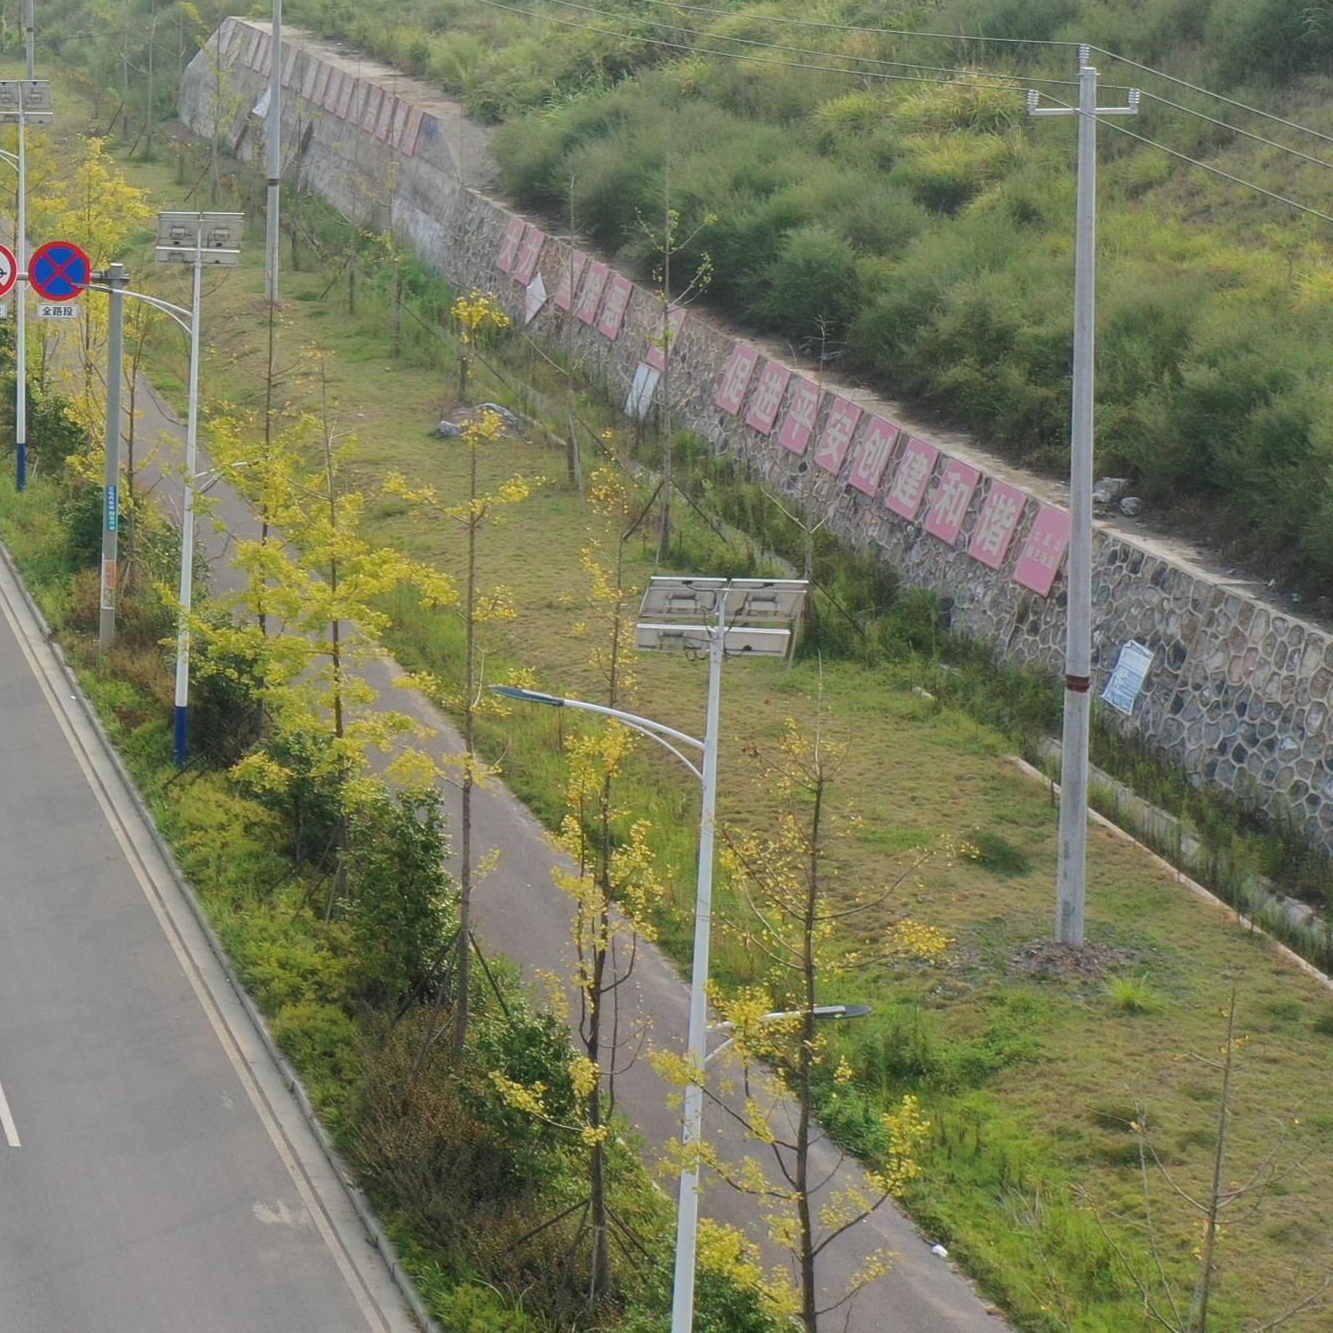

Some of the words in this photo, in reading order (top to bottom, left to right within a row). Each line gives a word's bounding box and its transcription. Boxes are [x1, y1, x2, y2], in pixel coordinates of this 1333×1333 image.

[42, 306, 73, 316] 全路段
[721, 354, 1017, 557] 促进平安创建和谐
